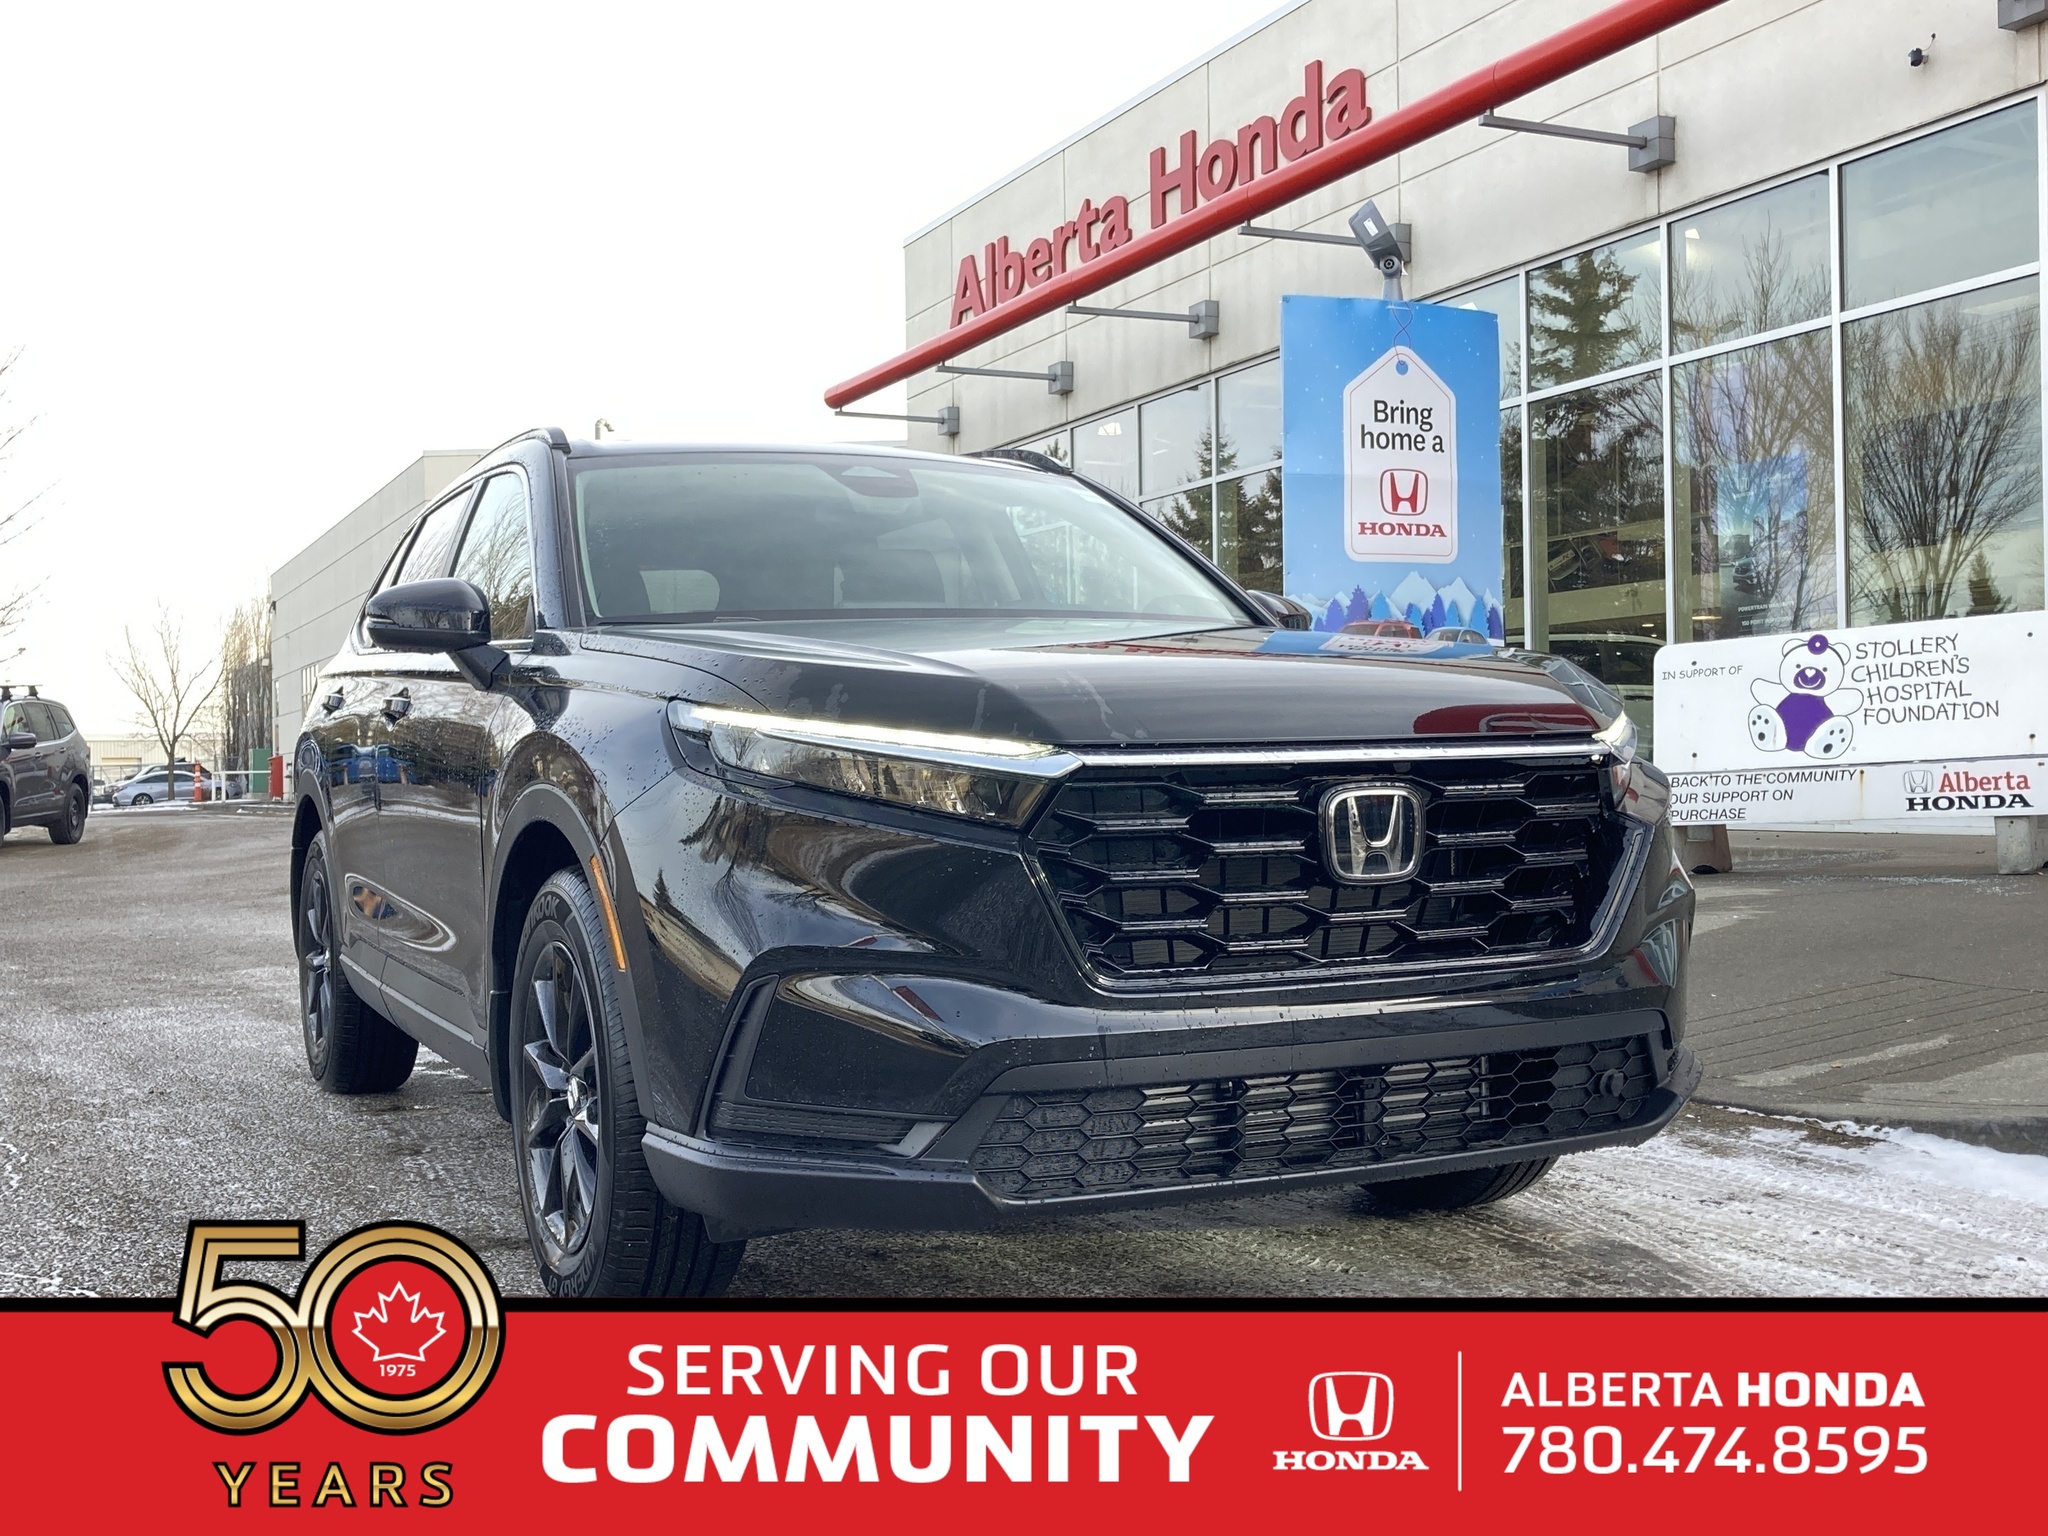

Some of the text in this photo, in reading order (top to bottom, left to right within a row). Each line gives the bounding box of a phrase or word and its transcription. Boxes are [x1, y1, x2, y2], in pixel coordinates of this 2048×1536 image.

[950, 60, 1372, 329] Alberta Honda
[1374, 399, 1433, 433] Bring
[1361, 424, 1445, 453] home a
[1358, 521, 1447, 538] HONDA
[1856, 633, 1958, 659] STOLLERY
[1662, 664, 1743, 680] IN SUPPORT OF
[1851, 655, 1970, 683] CHILDREN'S
[1867, 680, 1972, 705] HOSPITAL
[1864, 700, 1999, 725] FOUNDATION
[1671, 769, 1857, 787] BACK TO THE COMMUNITY
[1938, 771, 2031, 793] Alberta
[1702, 790, 1769, 803] SUPPORT
[1772, 789, 1794, 801] ON
[1905, 794, 2034, 811] HONDA
[1671, 808, 1746, 820] PURCHASE
